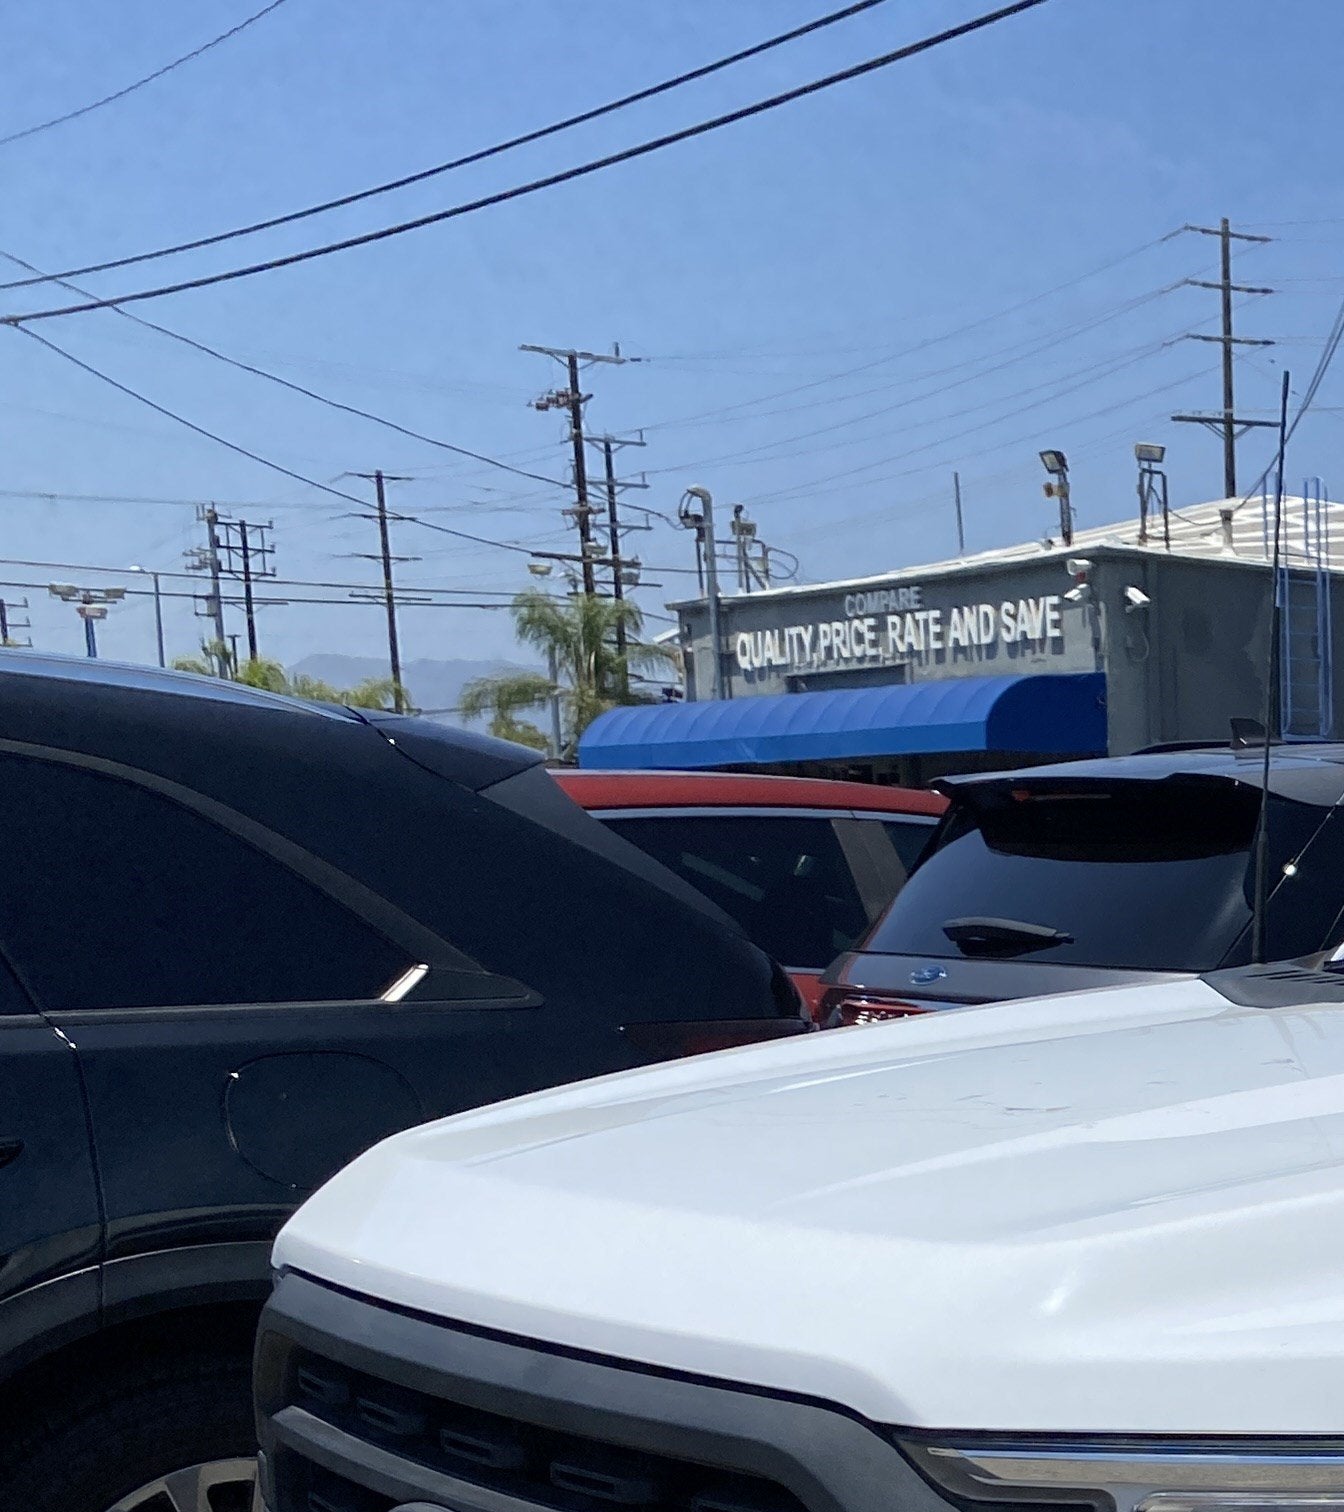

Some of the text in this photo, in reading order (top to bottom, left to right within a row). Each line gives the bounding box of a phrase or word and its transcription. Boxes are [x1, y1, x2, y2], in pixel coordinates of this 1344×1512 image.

[844, 586, 922, 617] COMPARE
[887, 609, 943, 653] RATE
[949, 603, 995, 647] AND
[1001, 595, 1061, 642] SAVE
